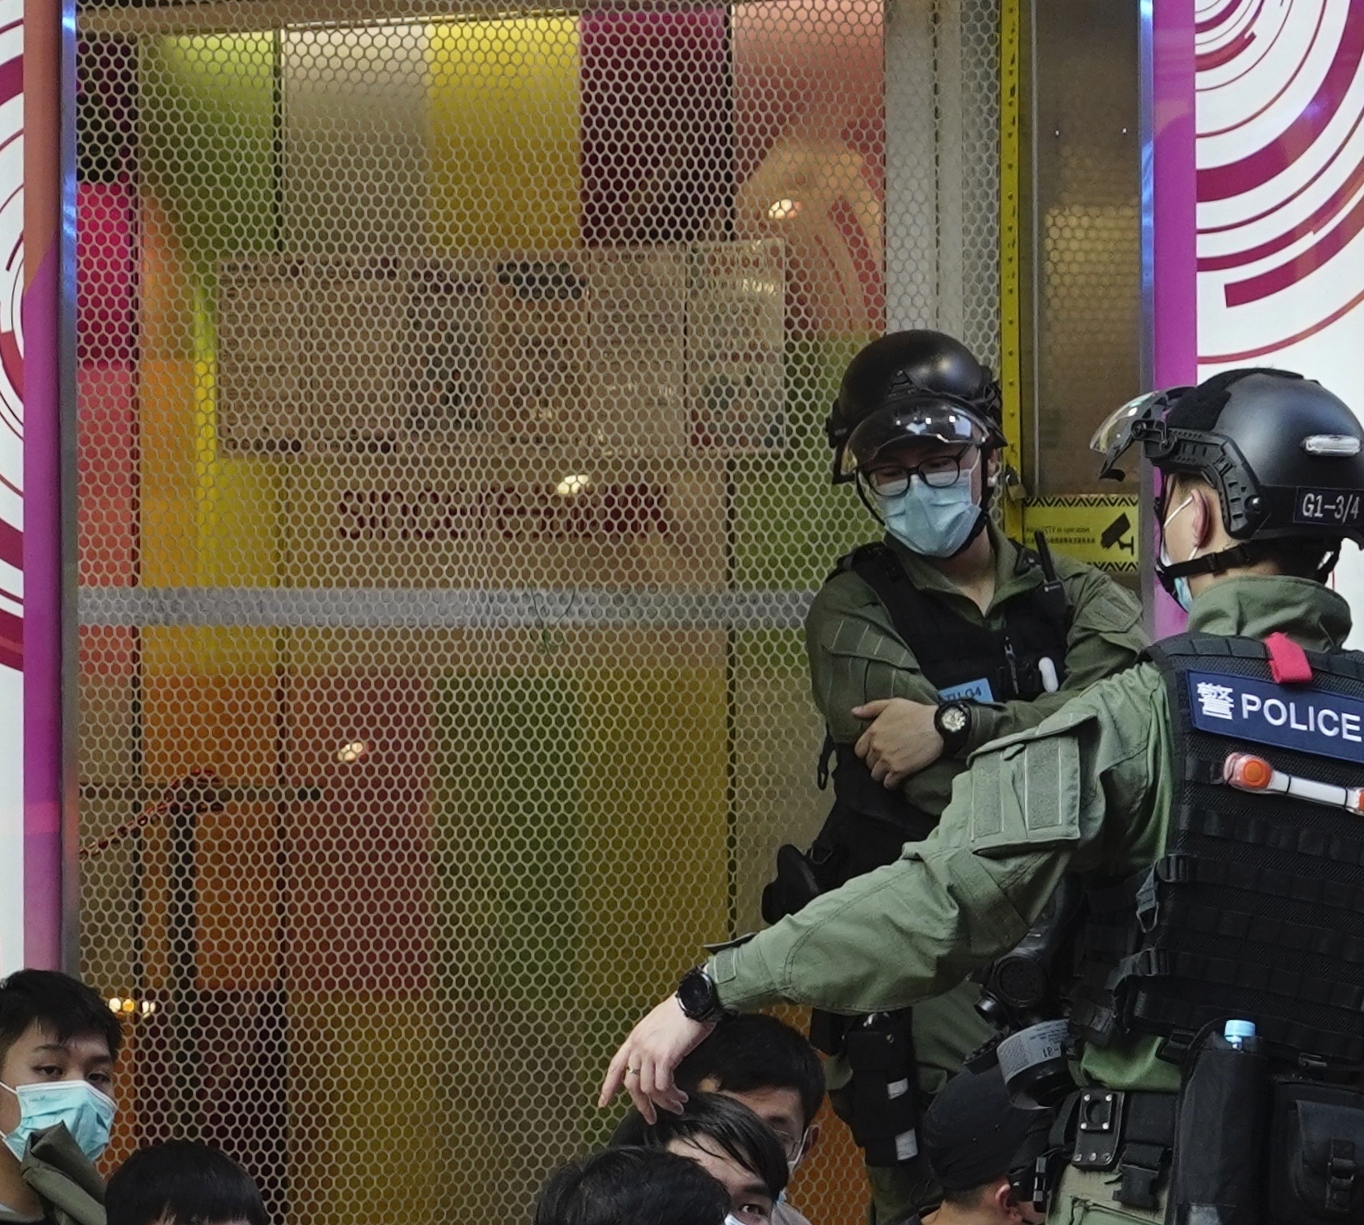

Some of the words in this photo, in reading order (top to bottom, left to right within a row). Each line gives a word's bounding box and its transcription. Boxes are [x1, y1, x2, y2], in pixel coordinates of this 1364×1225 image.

[1301, 493, 1361, 521] G1-3/4
[1197, 682, 1235, 721] 警
[1240, 693, 1363, 743] POLICE
